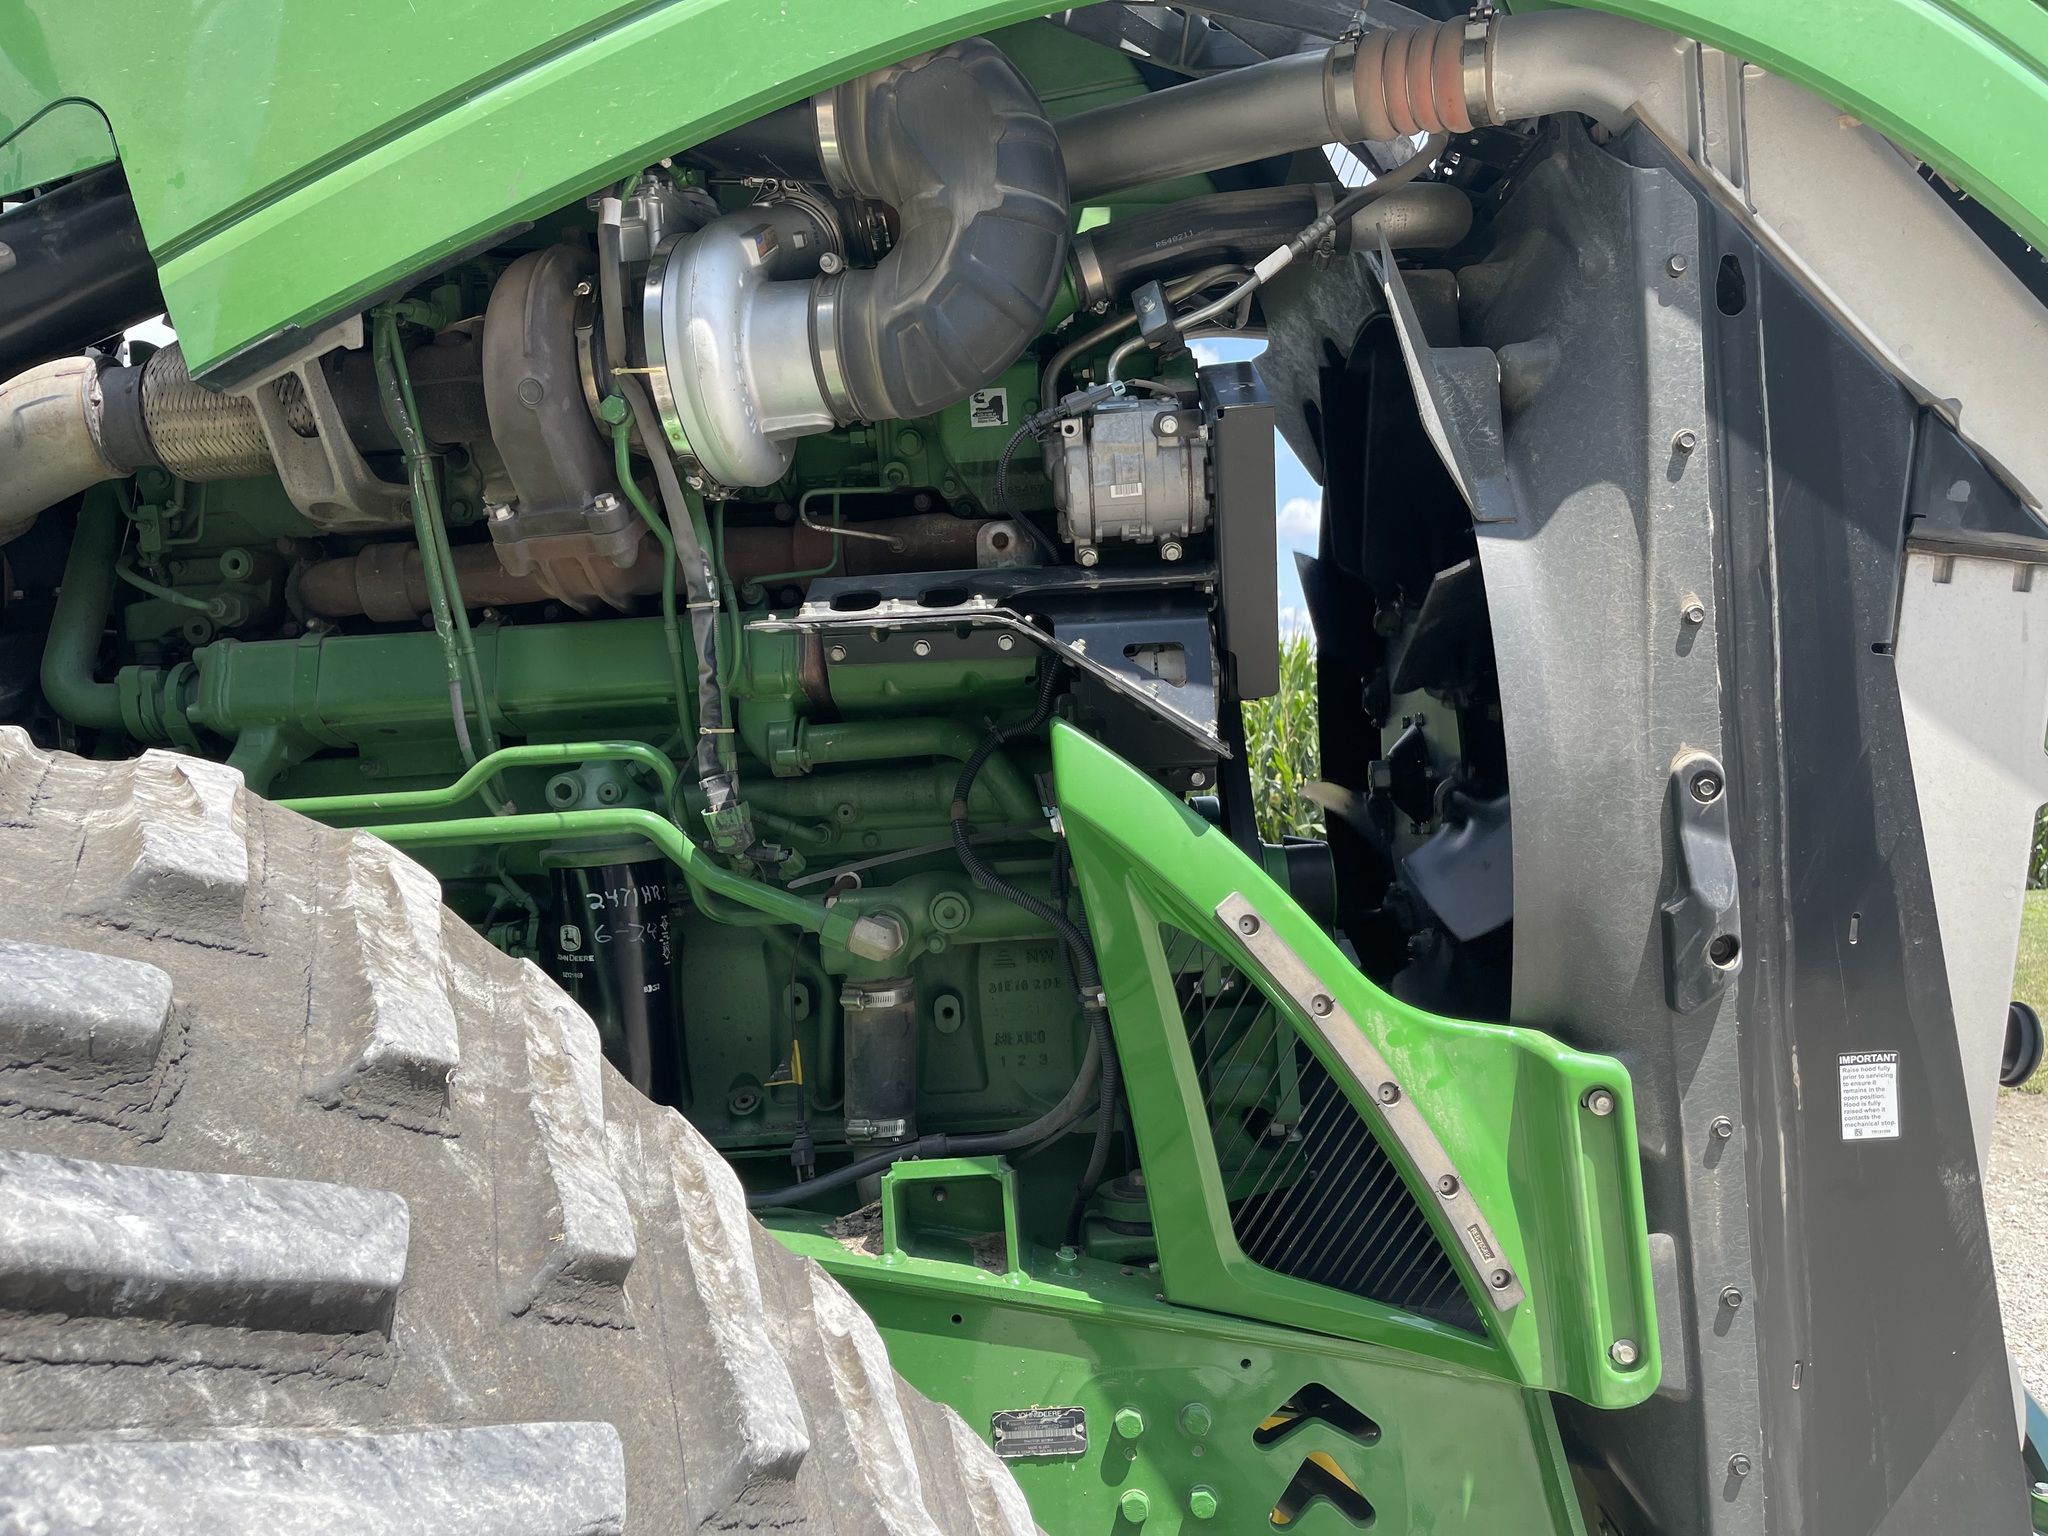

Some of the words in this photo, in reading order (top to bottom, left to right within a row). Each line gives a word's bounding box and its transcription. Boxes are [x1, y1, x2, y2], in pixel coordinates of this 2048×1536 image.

[586, 887, 638, 909] 2471
[569, 954, 595, 962] DEERE
[994, 1030, 1046, 1046] MEXICO
[1839, 1053, 1897, 1064] IMPORTANT
